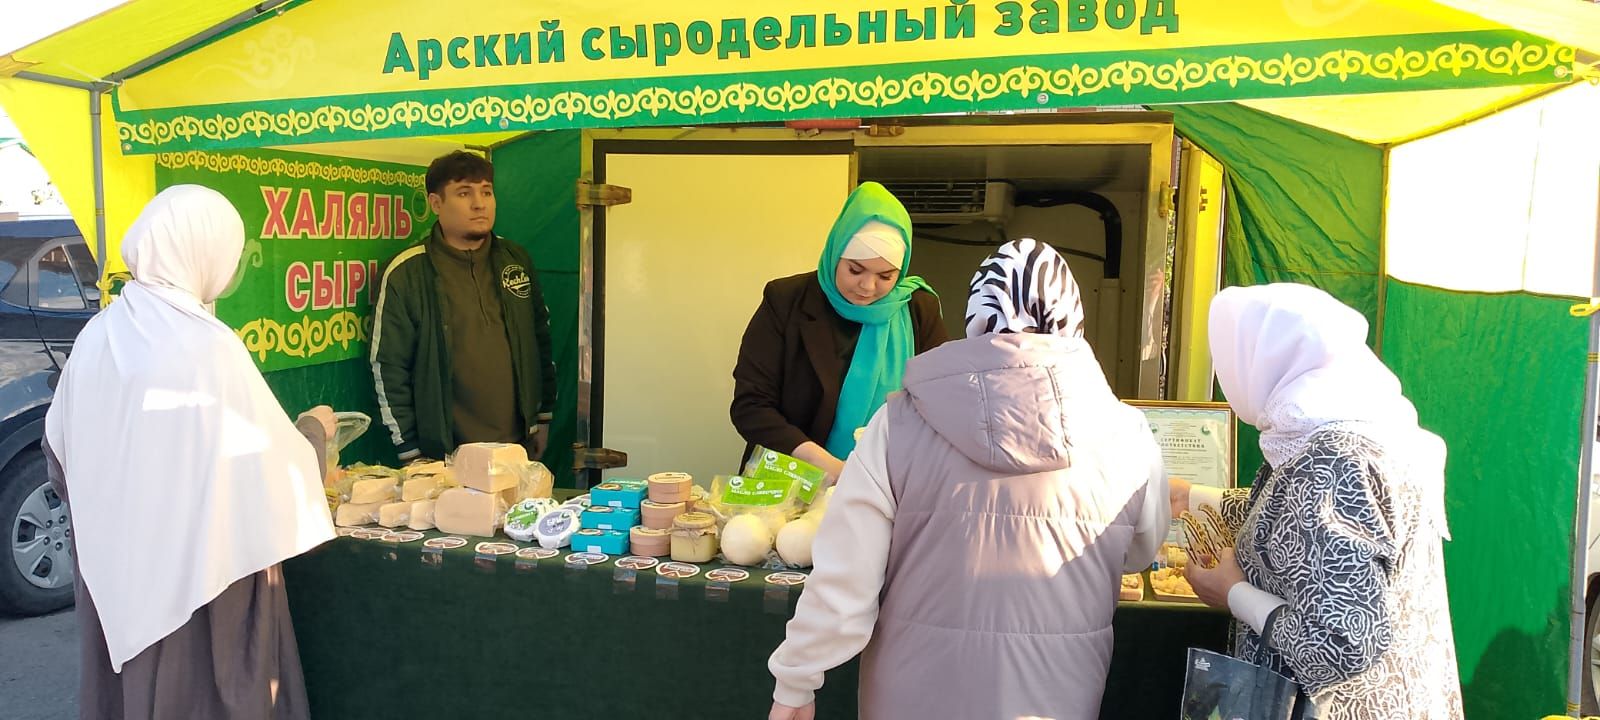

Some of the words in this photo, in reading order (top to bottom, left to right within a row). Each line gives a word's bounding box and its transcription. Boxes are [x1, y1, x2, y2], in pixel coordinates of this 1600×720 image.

[382, 19, 566, 80] Арский
[580, 0, 976, 67] сыродельный
[994, 0, 1180, 37] завод
[259, 185, 413, 240] ХАЛЯЛЬ
